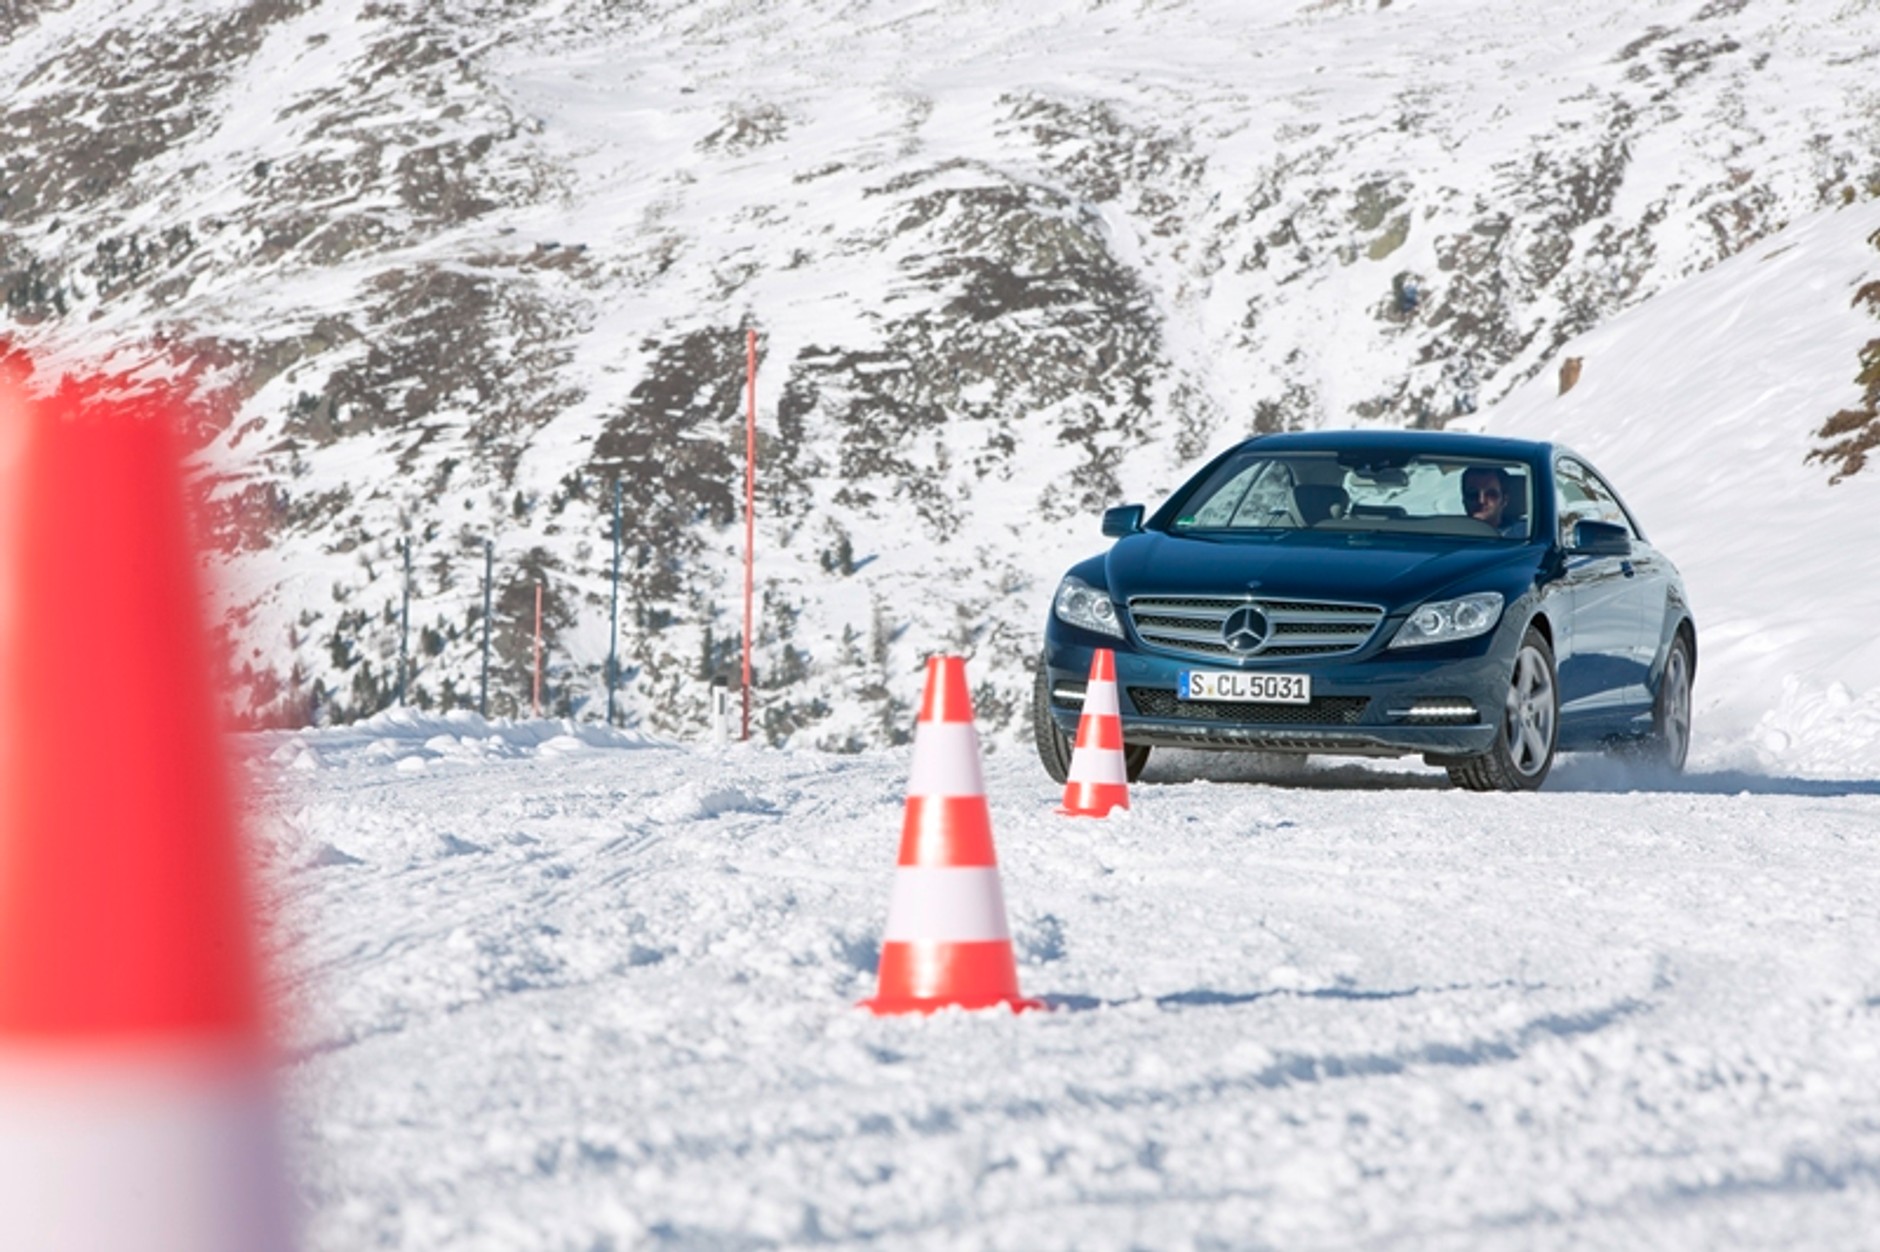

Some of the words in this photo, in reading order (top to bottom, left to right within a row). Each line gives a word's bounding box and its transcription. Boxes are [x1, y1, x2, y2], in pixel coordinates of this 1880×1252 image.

[1190, 673, 1204, 696] S
[1217, 674, 1245, 696] CL
[1250, 676, 1305, 699] 5031
